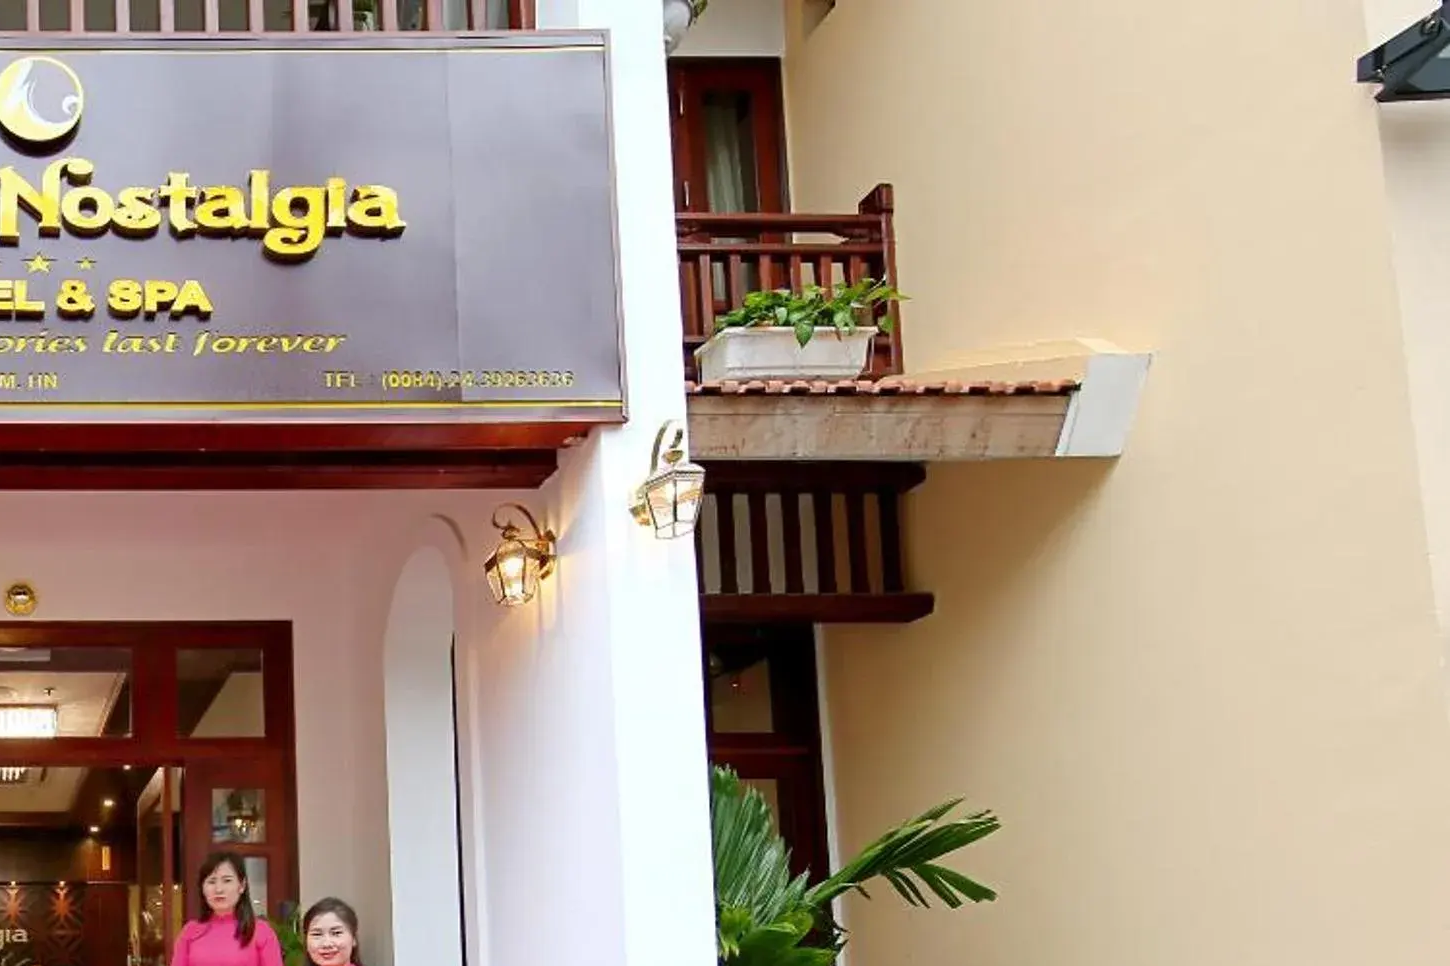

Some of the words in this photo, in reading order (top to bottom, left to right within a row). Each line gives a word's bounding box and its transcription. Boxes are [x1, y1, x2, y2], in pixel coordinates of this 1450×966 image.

[56, 279, 95, 320] &
[107, 279, 214, 321] SPA
[101, 329, 182, 354] last
[192, 329, 347, 356] forever
[28, 371, 58, 389] HN
